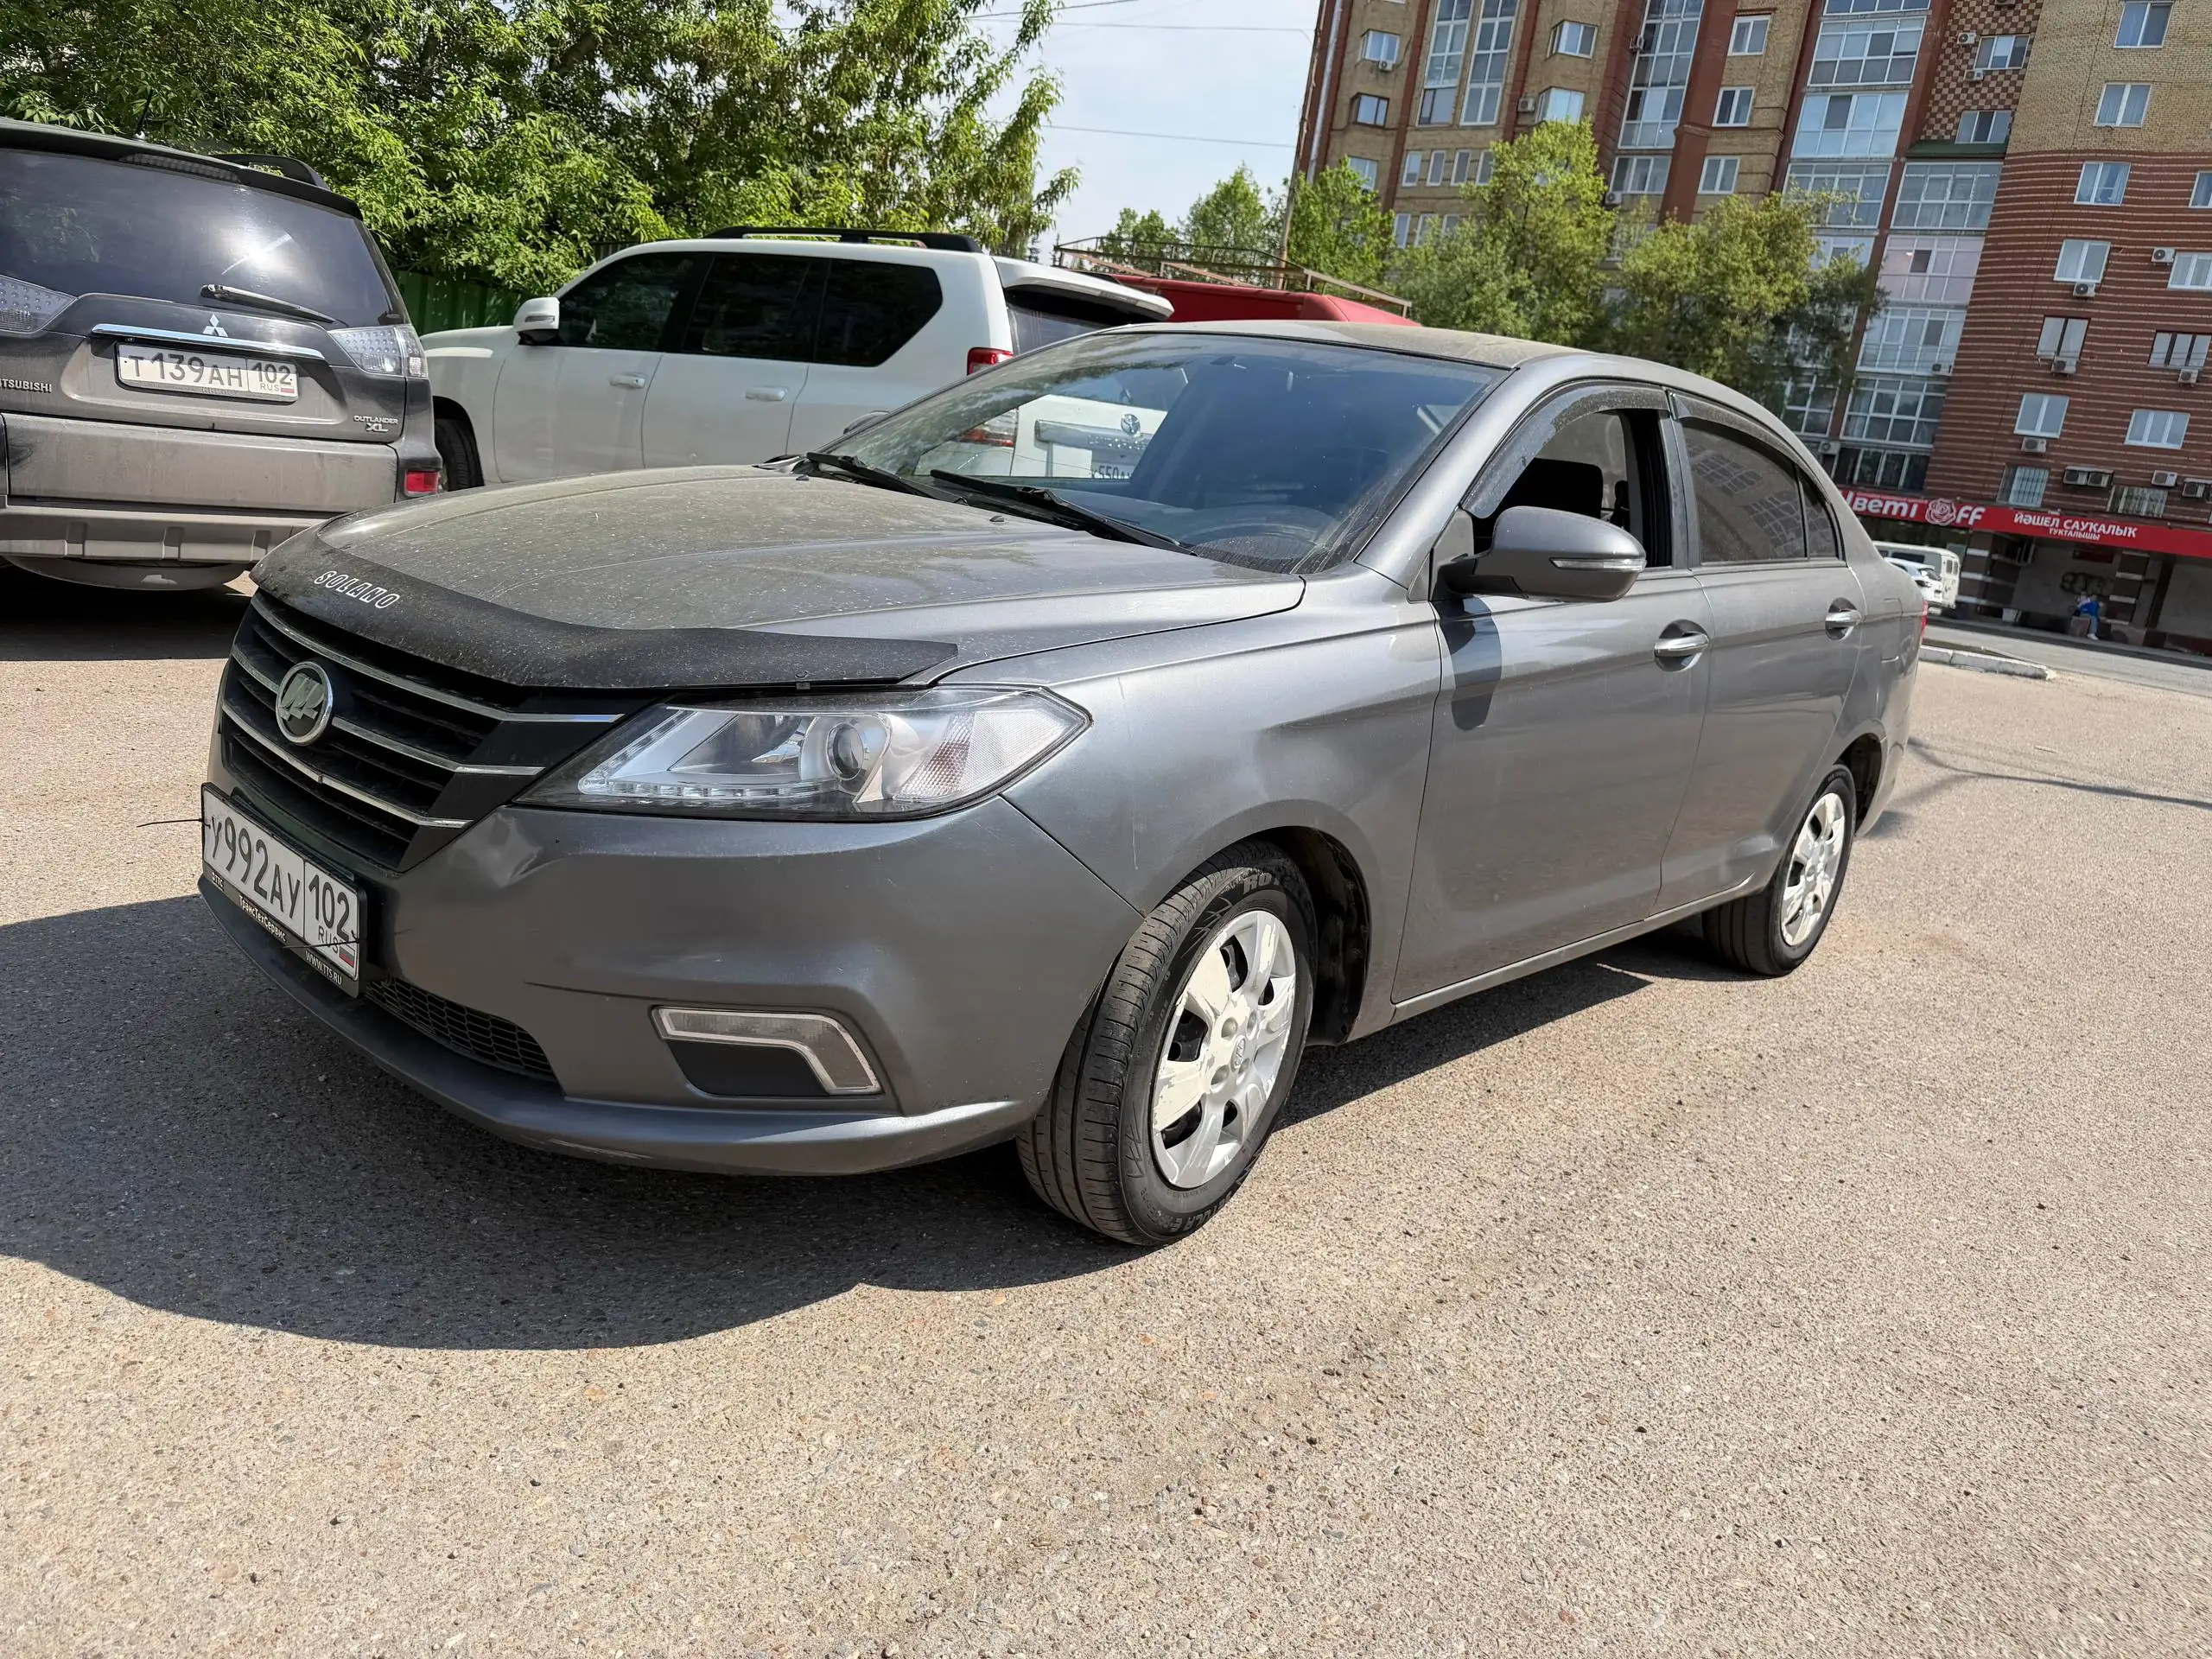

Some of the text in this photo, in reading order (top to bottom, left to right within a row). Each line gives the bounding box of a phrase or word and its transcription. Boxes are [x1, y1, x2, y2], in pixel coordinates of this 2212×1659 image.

[128, 352, 292, 387] Т139АН 102
[0, 378, 52, 392] TSUBISHI
[260, 382, 280, 391] RUS
[353, 416, 398, 424] OUTLANDER
[366, 423, 389, 432] XL
[314, 570, 401, 608] SOLANO
[211, 816, 350, 942] У992АУ 102
[318, 925, 338, 954] RUS
[305, 948, 342, 985] WWW.TTS.RU
